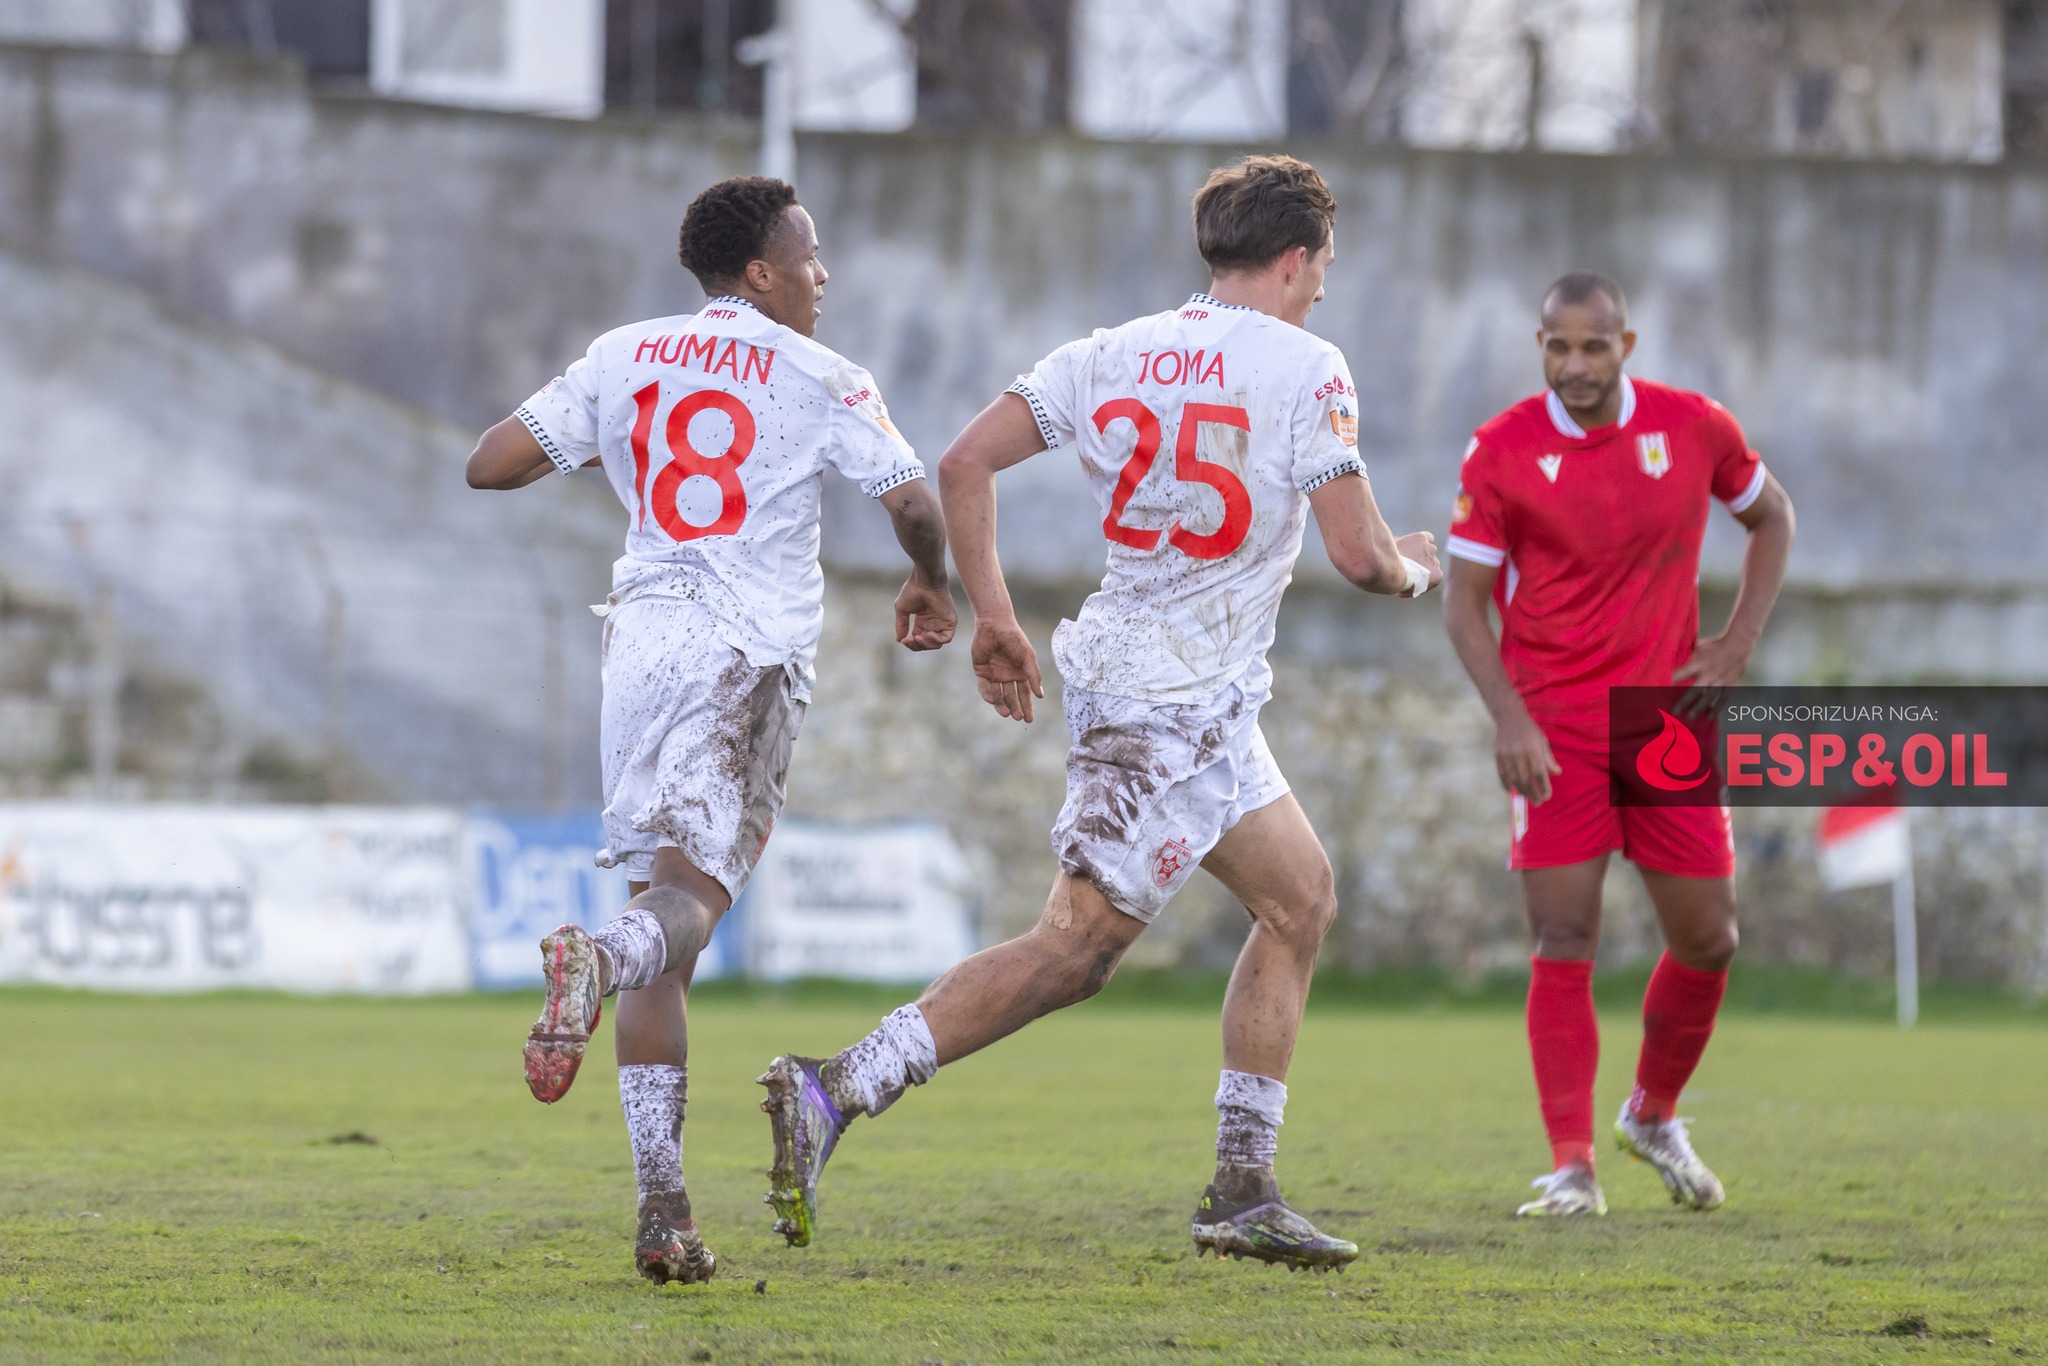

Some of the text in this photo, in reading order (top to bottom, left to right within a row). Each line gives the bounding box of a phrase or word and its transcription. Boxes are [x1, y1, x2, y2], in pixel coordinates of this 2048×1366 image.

[704, 309, 738, 320] PMTP
[634, 333, 776, 385] HUMAN
[1137, 349, 1224, 389] TOMA
[630, 379, 757, 543] 18
[1091, 397, 1253, 561] 25
